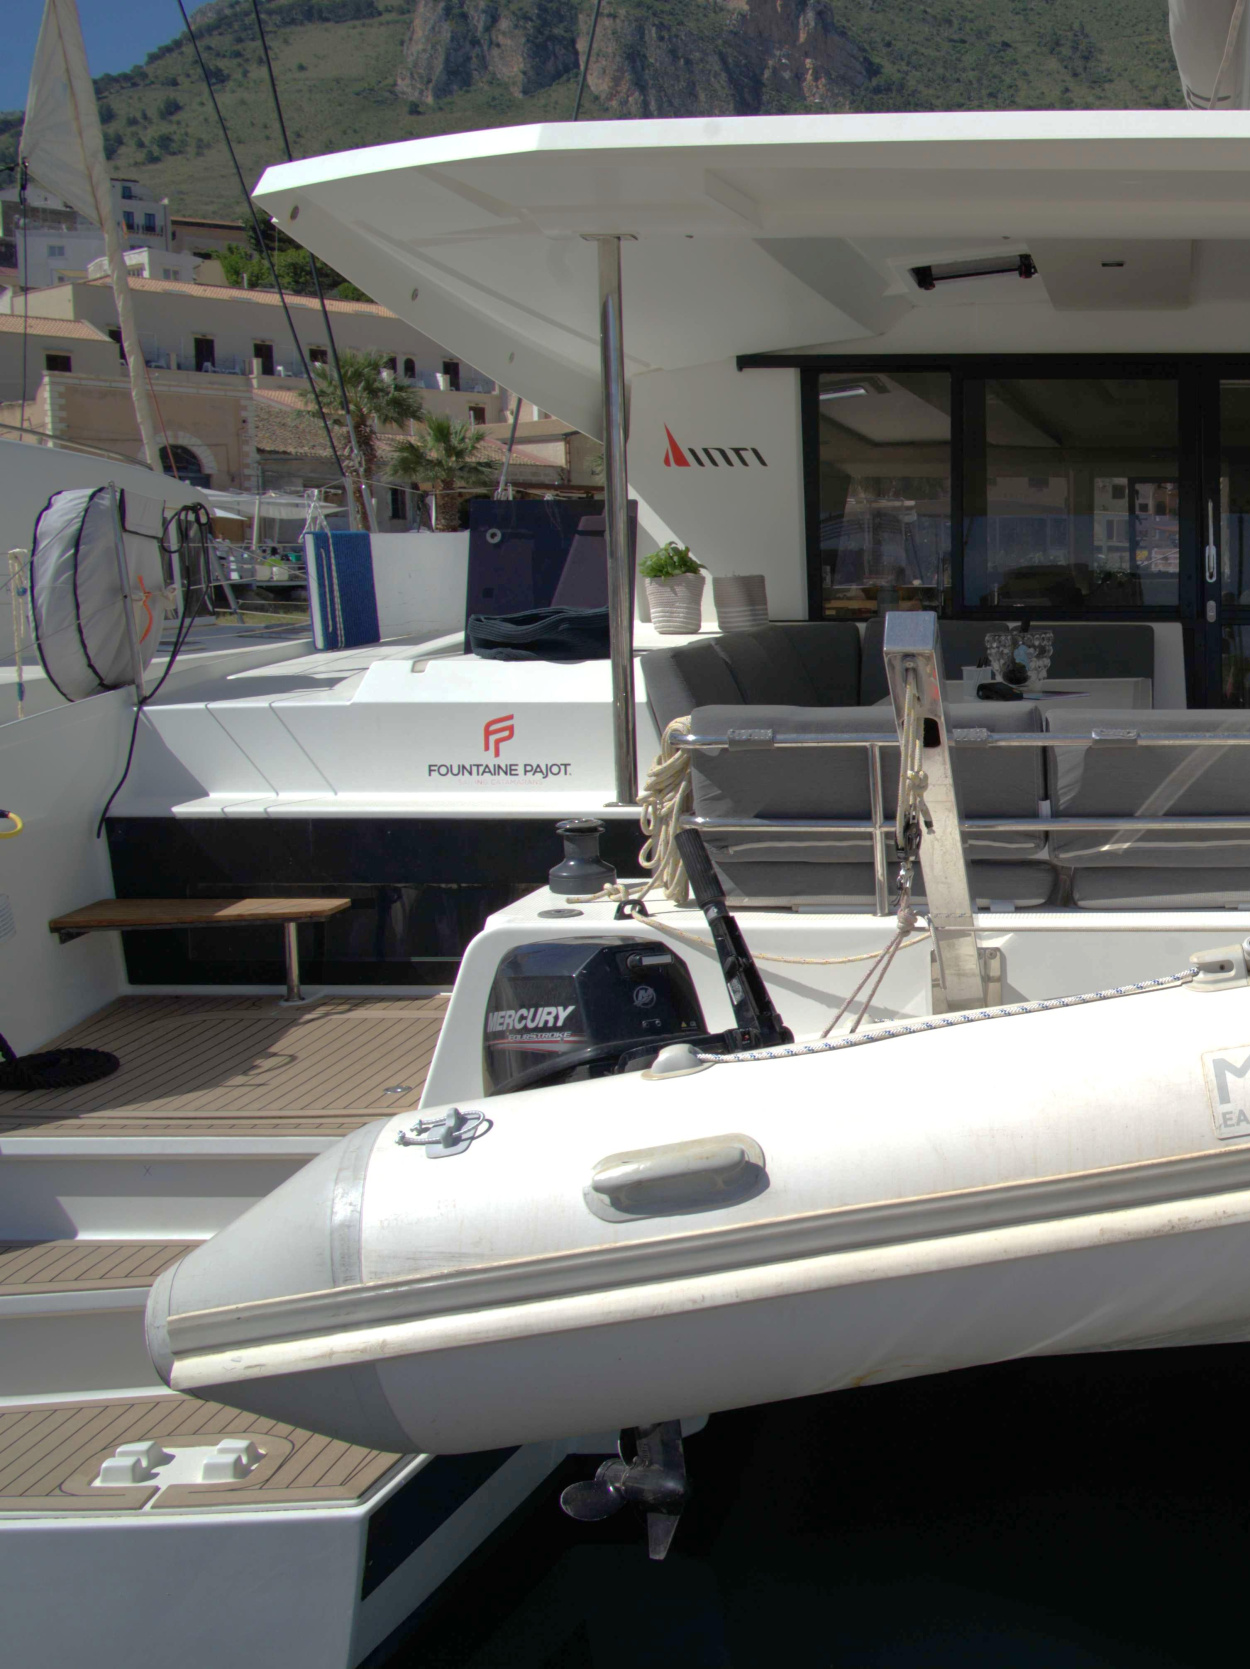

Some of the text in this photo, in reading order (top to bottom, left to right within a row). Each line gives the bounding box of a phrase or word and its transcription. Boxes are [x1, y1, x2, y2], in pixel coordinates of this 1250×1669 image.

[428, 763, 570, 779] FOUNTAINE PAJOT
[487, 1005, 576, 1033] MERCURY
